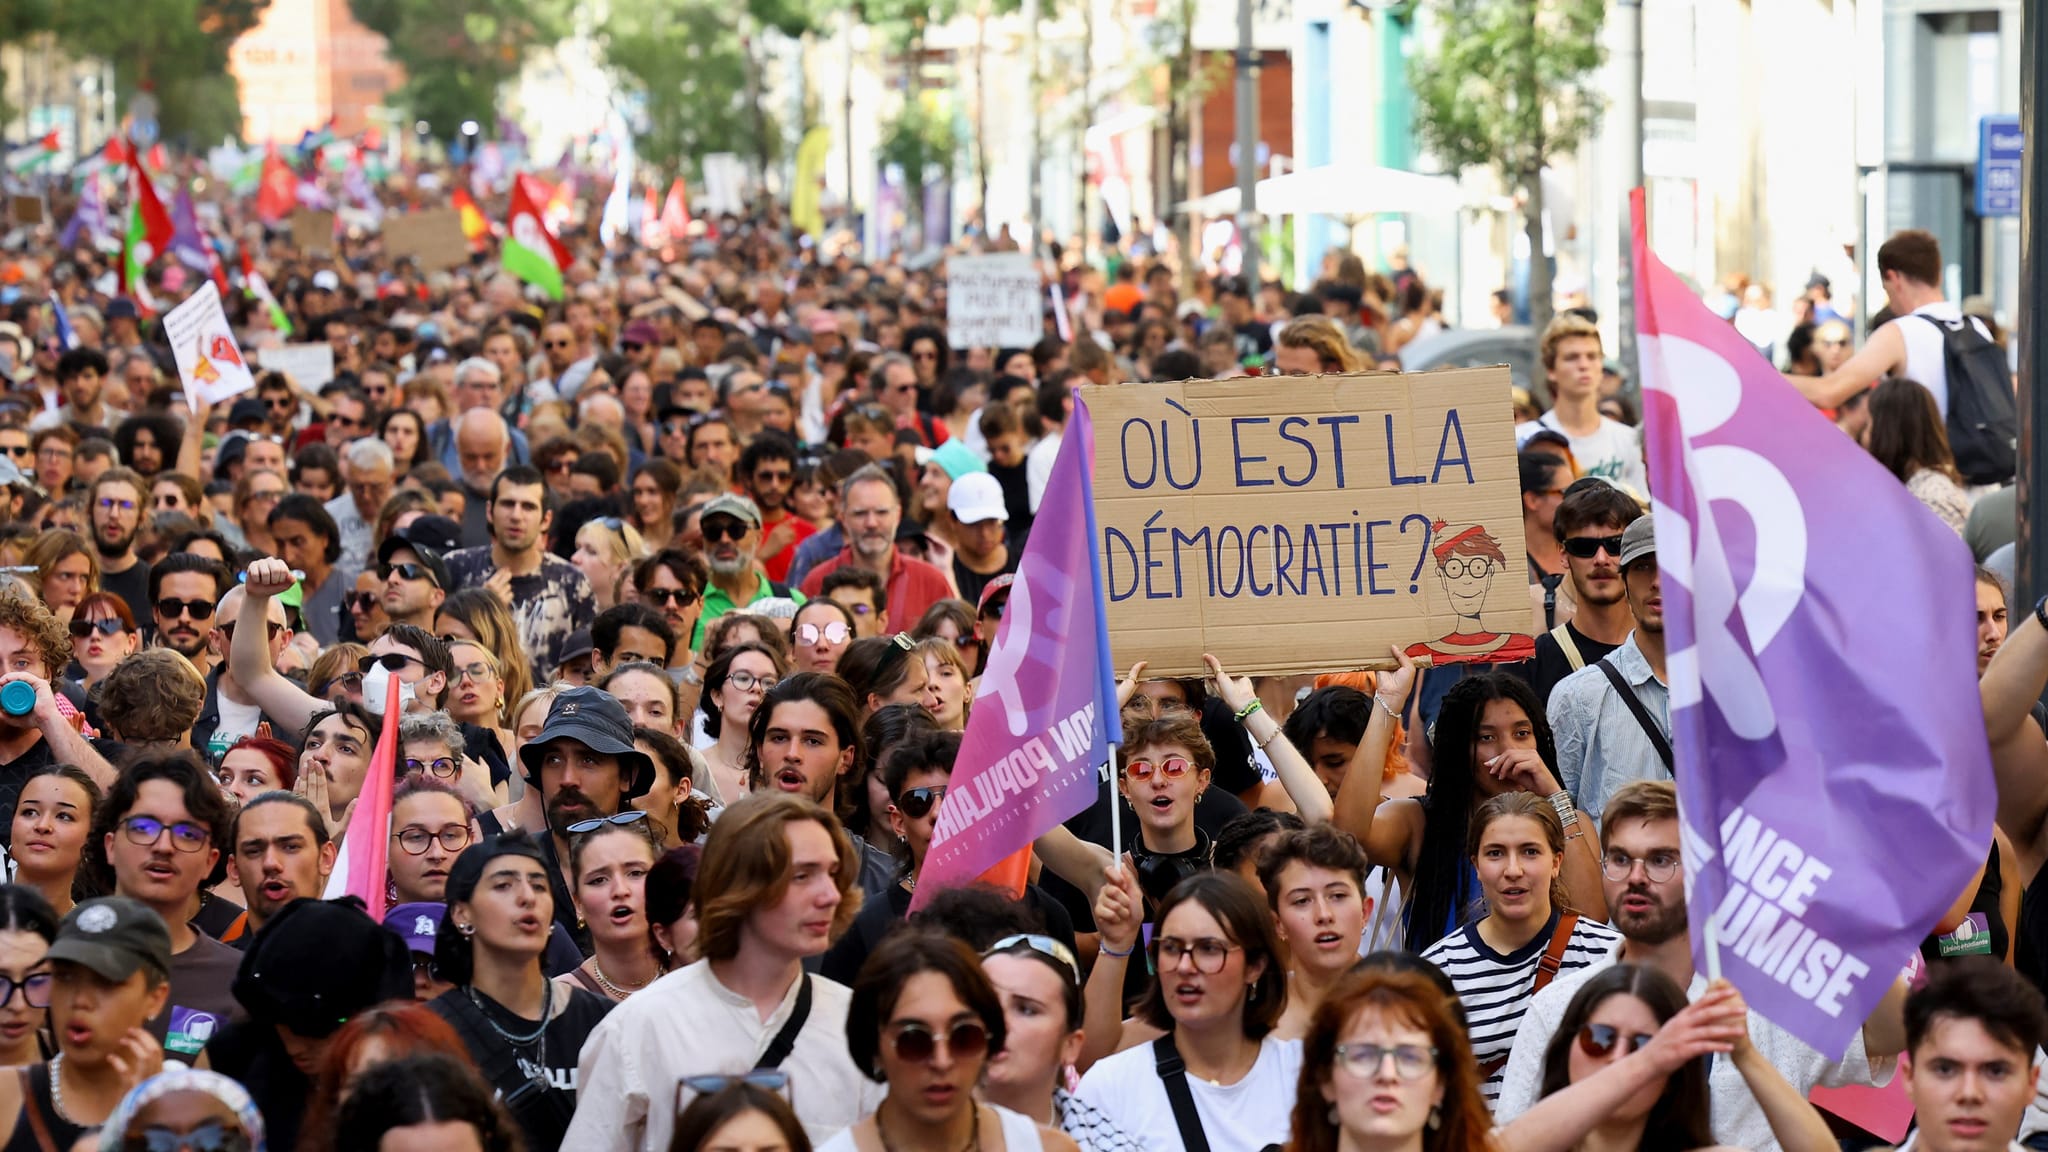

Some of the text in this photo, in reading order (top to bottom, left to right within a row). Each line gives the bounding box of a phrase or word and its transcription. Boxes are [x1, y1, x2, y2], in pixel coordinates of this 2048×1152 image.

[1121, 397, 1475, 490] OÙ EST LA
